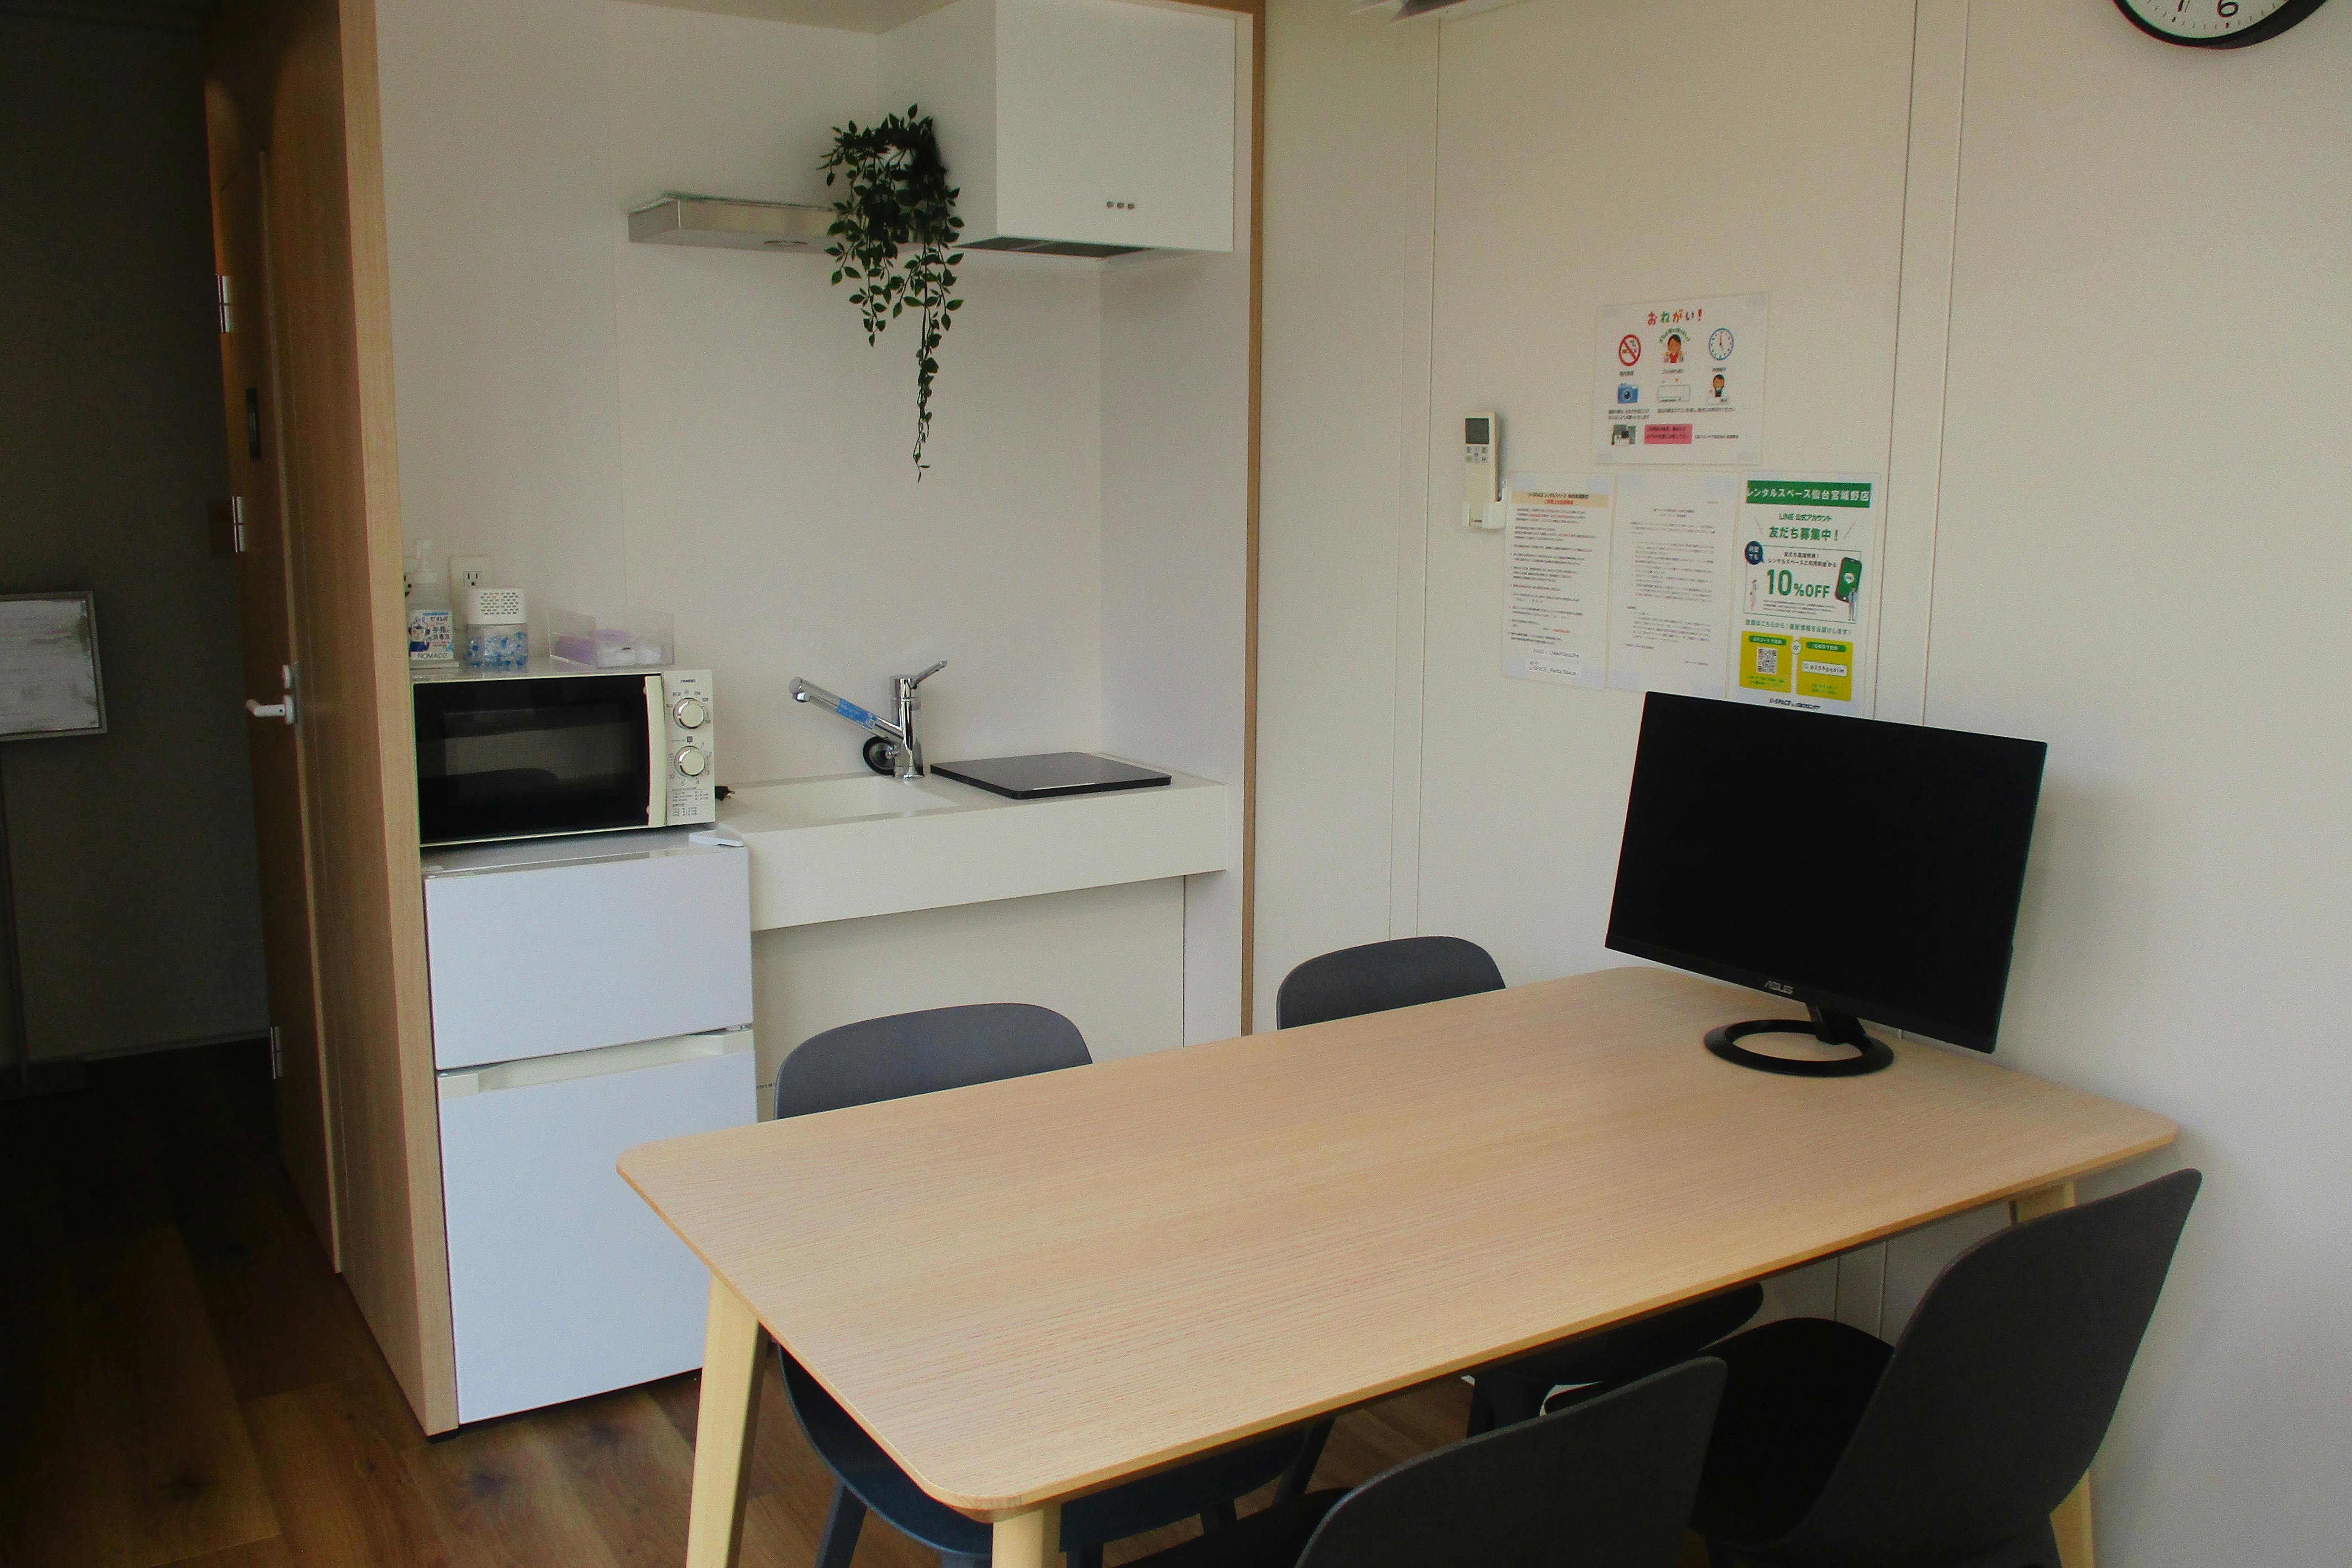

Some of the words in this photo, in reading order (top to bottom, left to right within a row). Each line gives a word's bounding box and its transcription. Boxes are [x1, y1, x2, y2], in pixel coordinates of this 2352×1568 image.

[1648, 309, 1702, 325] おねがい！
[1747, 488, 1869, 501] レンタルスペース仙台宮城野店
[1769, 526, 1839, 541] 友だち募集中！
[1767, 569, 1830, 598] 10%OFF
[1764, 980, 1794, 995] ASUS
